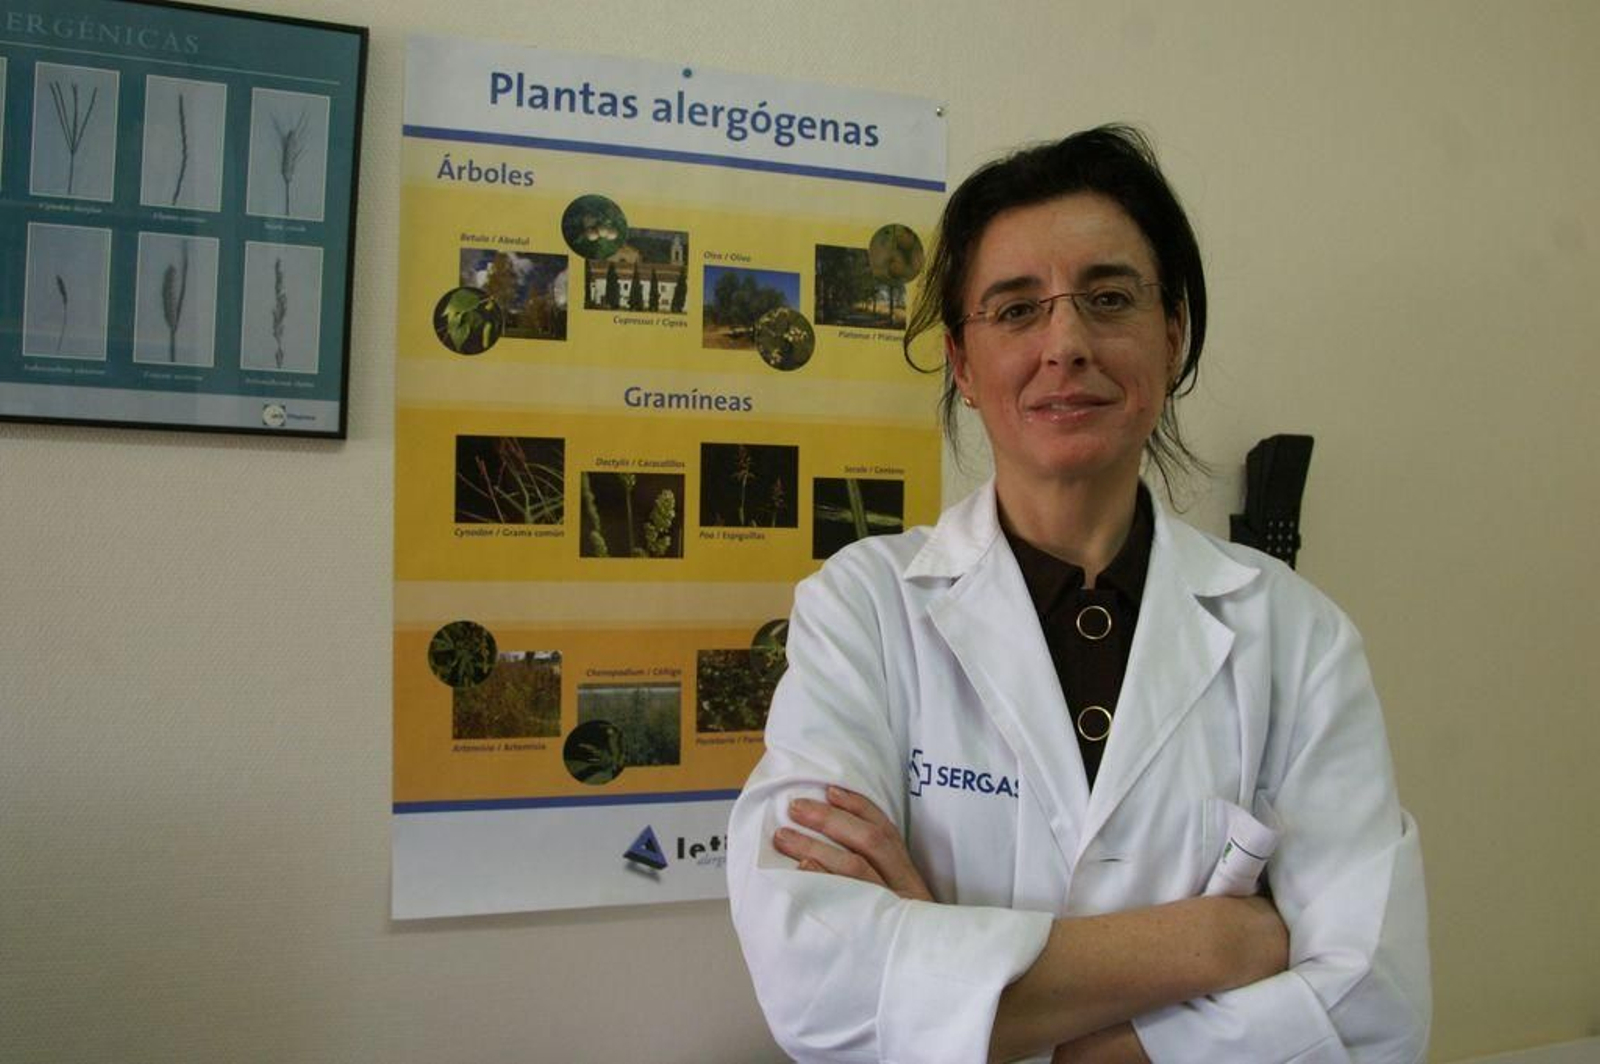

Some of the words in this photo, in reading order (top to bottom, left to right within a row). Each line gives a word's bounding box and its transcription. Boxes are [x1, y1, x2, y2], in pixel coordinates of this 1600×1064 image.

[6, 11, 200, 53] ERGÉNICAS
[490, 71, 638, 119] Plantas
[652, 91, 880, 148] alergógenas
[437, 153, 534, 187] Árboles
[498, 236, 530, 246] Abedul
[730, 253, 752, 263] Olivo
[624, 387, 753, 412] Gramíneas
[595, 457, 629, 469] Dactylis
[454, 527, 493, 538] Cynodon
[502, 528, 532, 537] Grama
